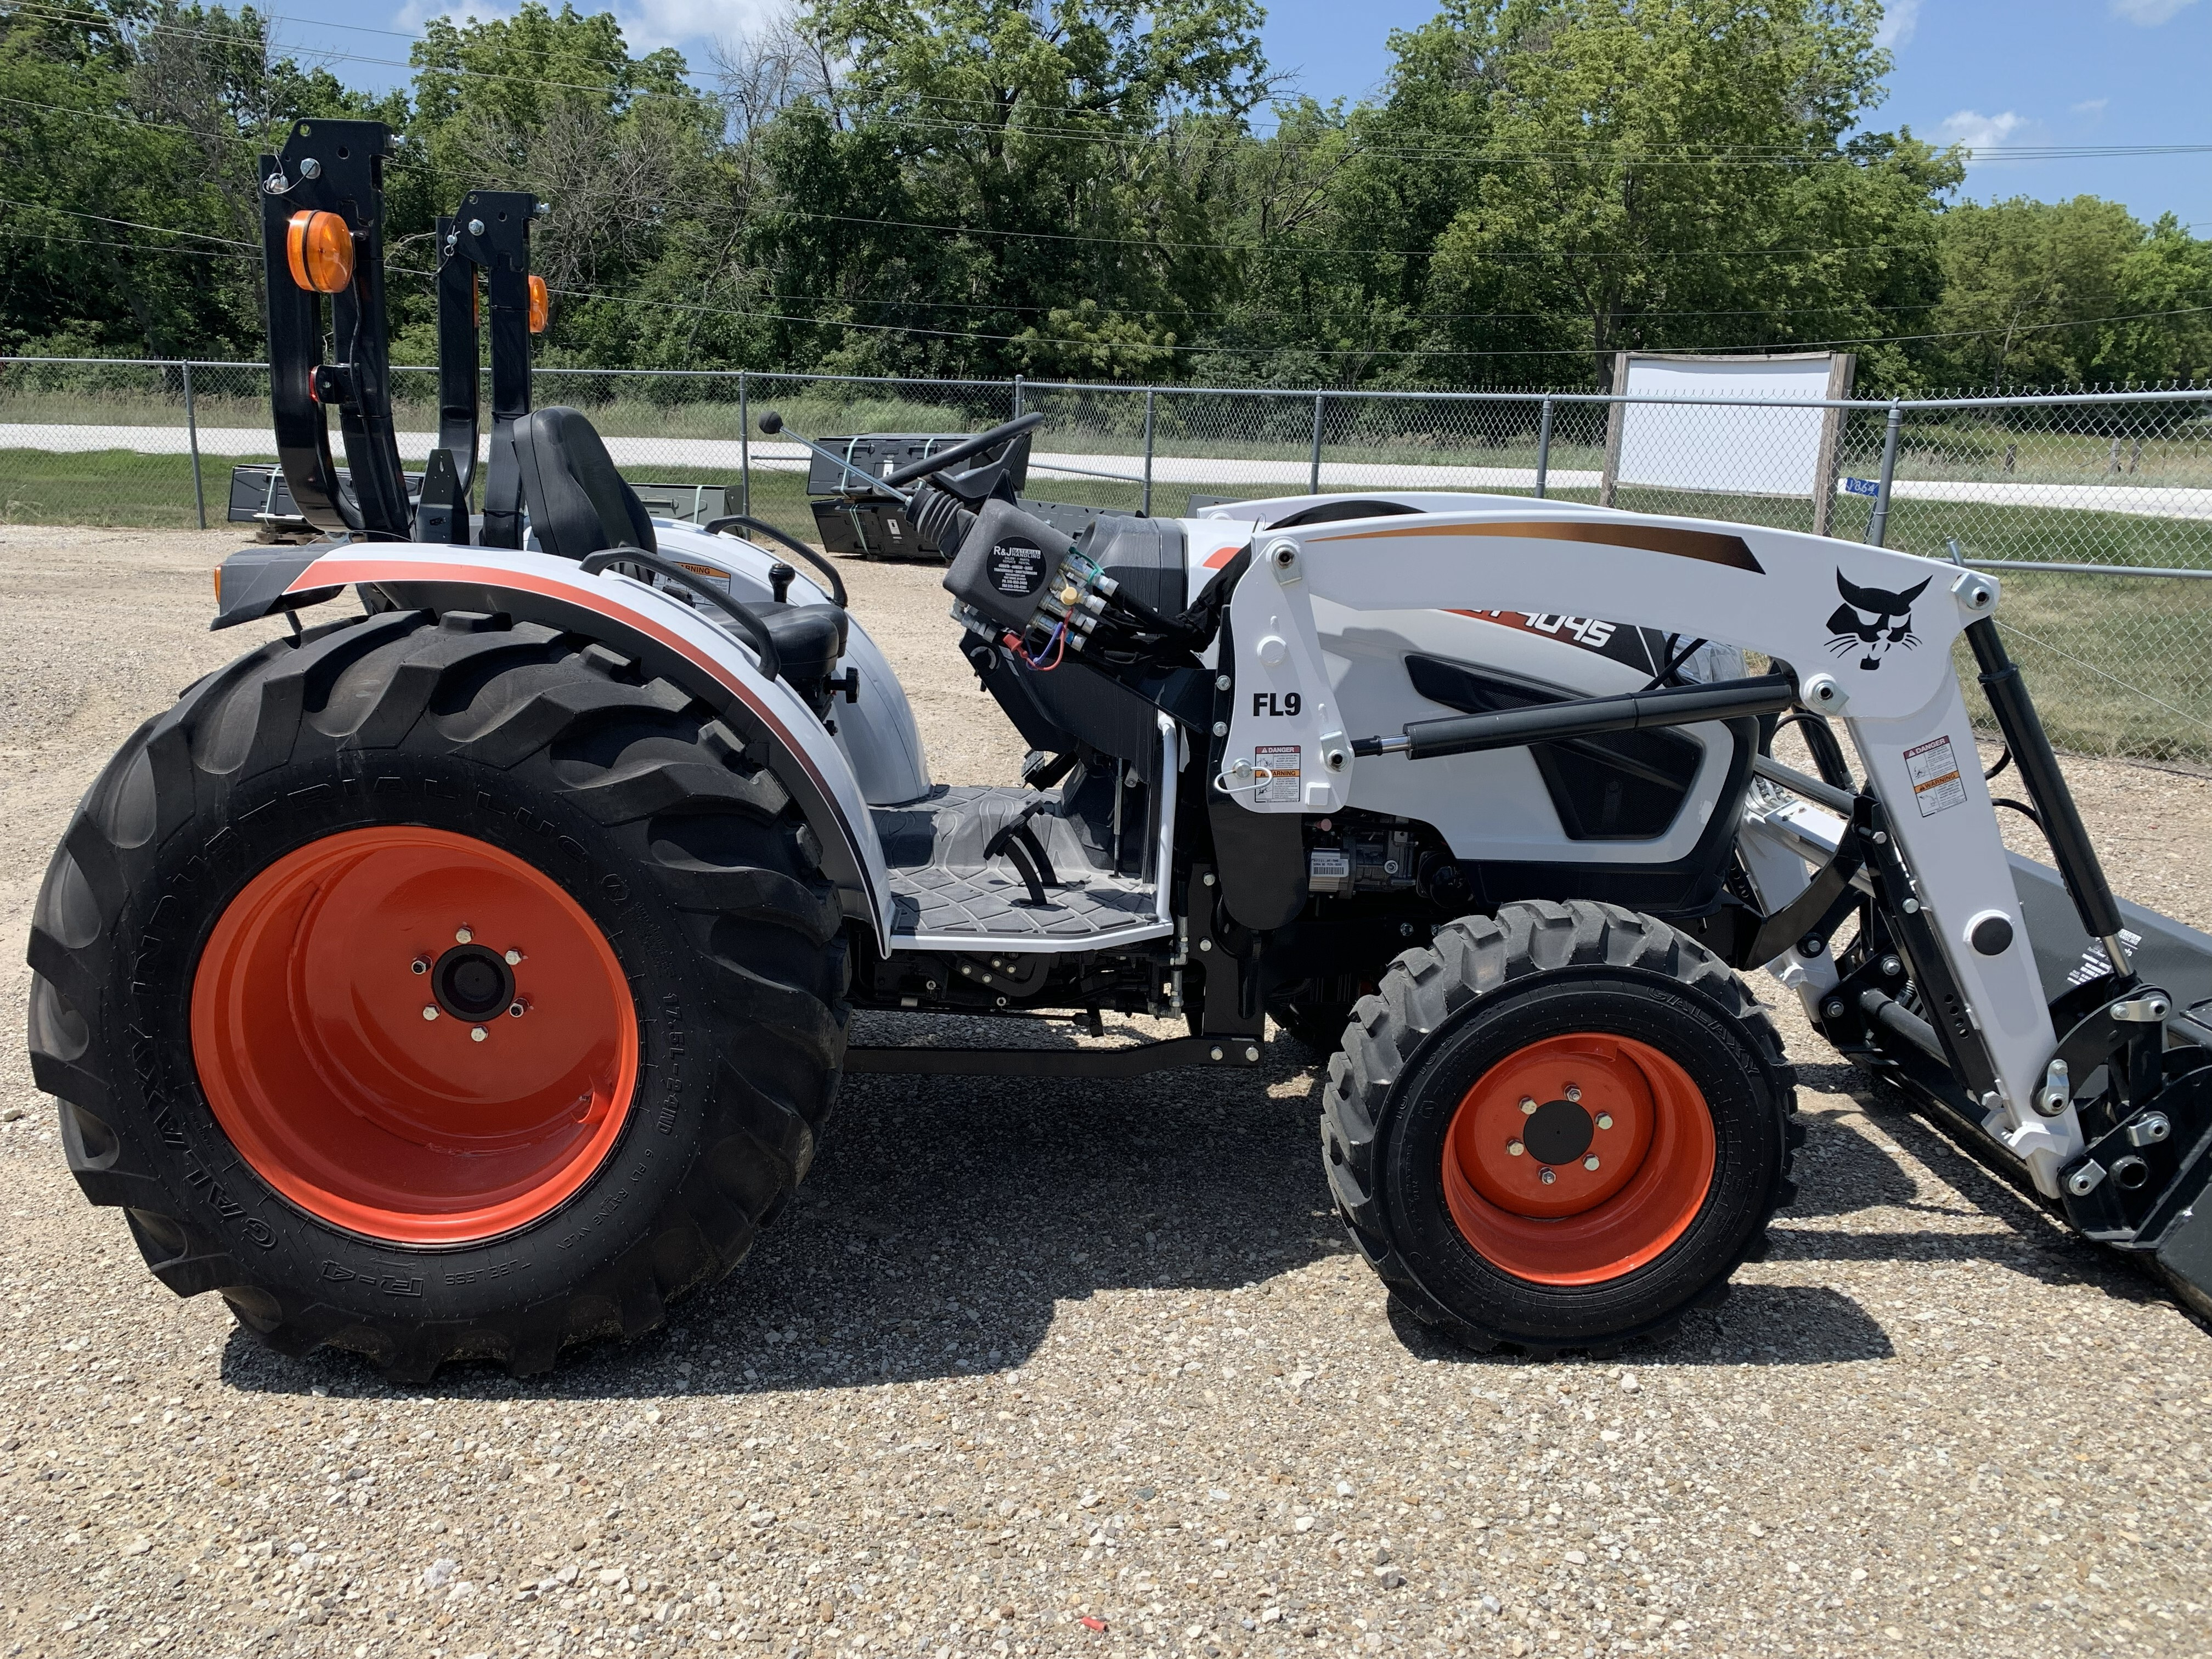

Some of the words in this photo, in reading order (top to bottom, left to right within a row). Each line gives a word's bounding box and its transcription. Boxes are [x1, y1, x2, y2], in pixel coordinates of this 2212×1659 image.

[994, 545, 1012, 556] R&J
[1254, 692, 1301, 716] FL9
[1916, 738, 1946, 754] DANGER
[1925, 774, 1955, 789] WARNING
[1647, 986, 1760, 1074] GALAXY
[129, 1023, 278, 1249] GALAXY
[321, 1259, 424, 1297] R-4
[445, 1259, 532, 1285] TUBELESS
